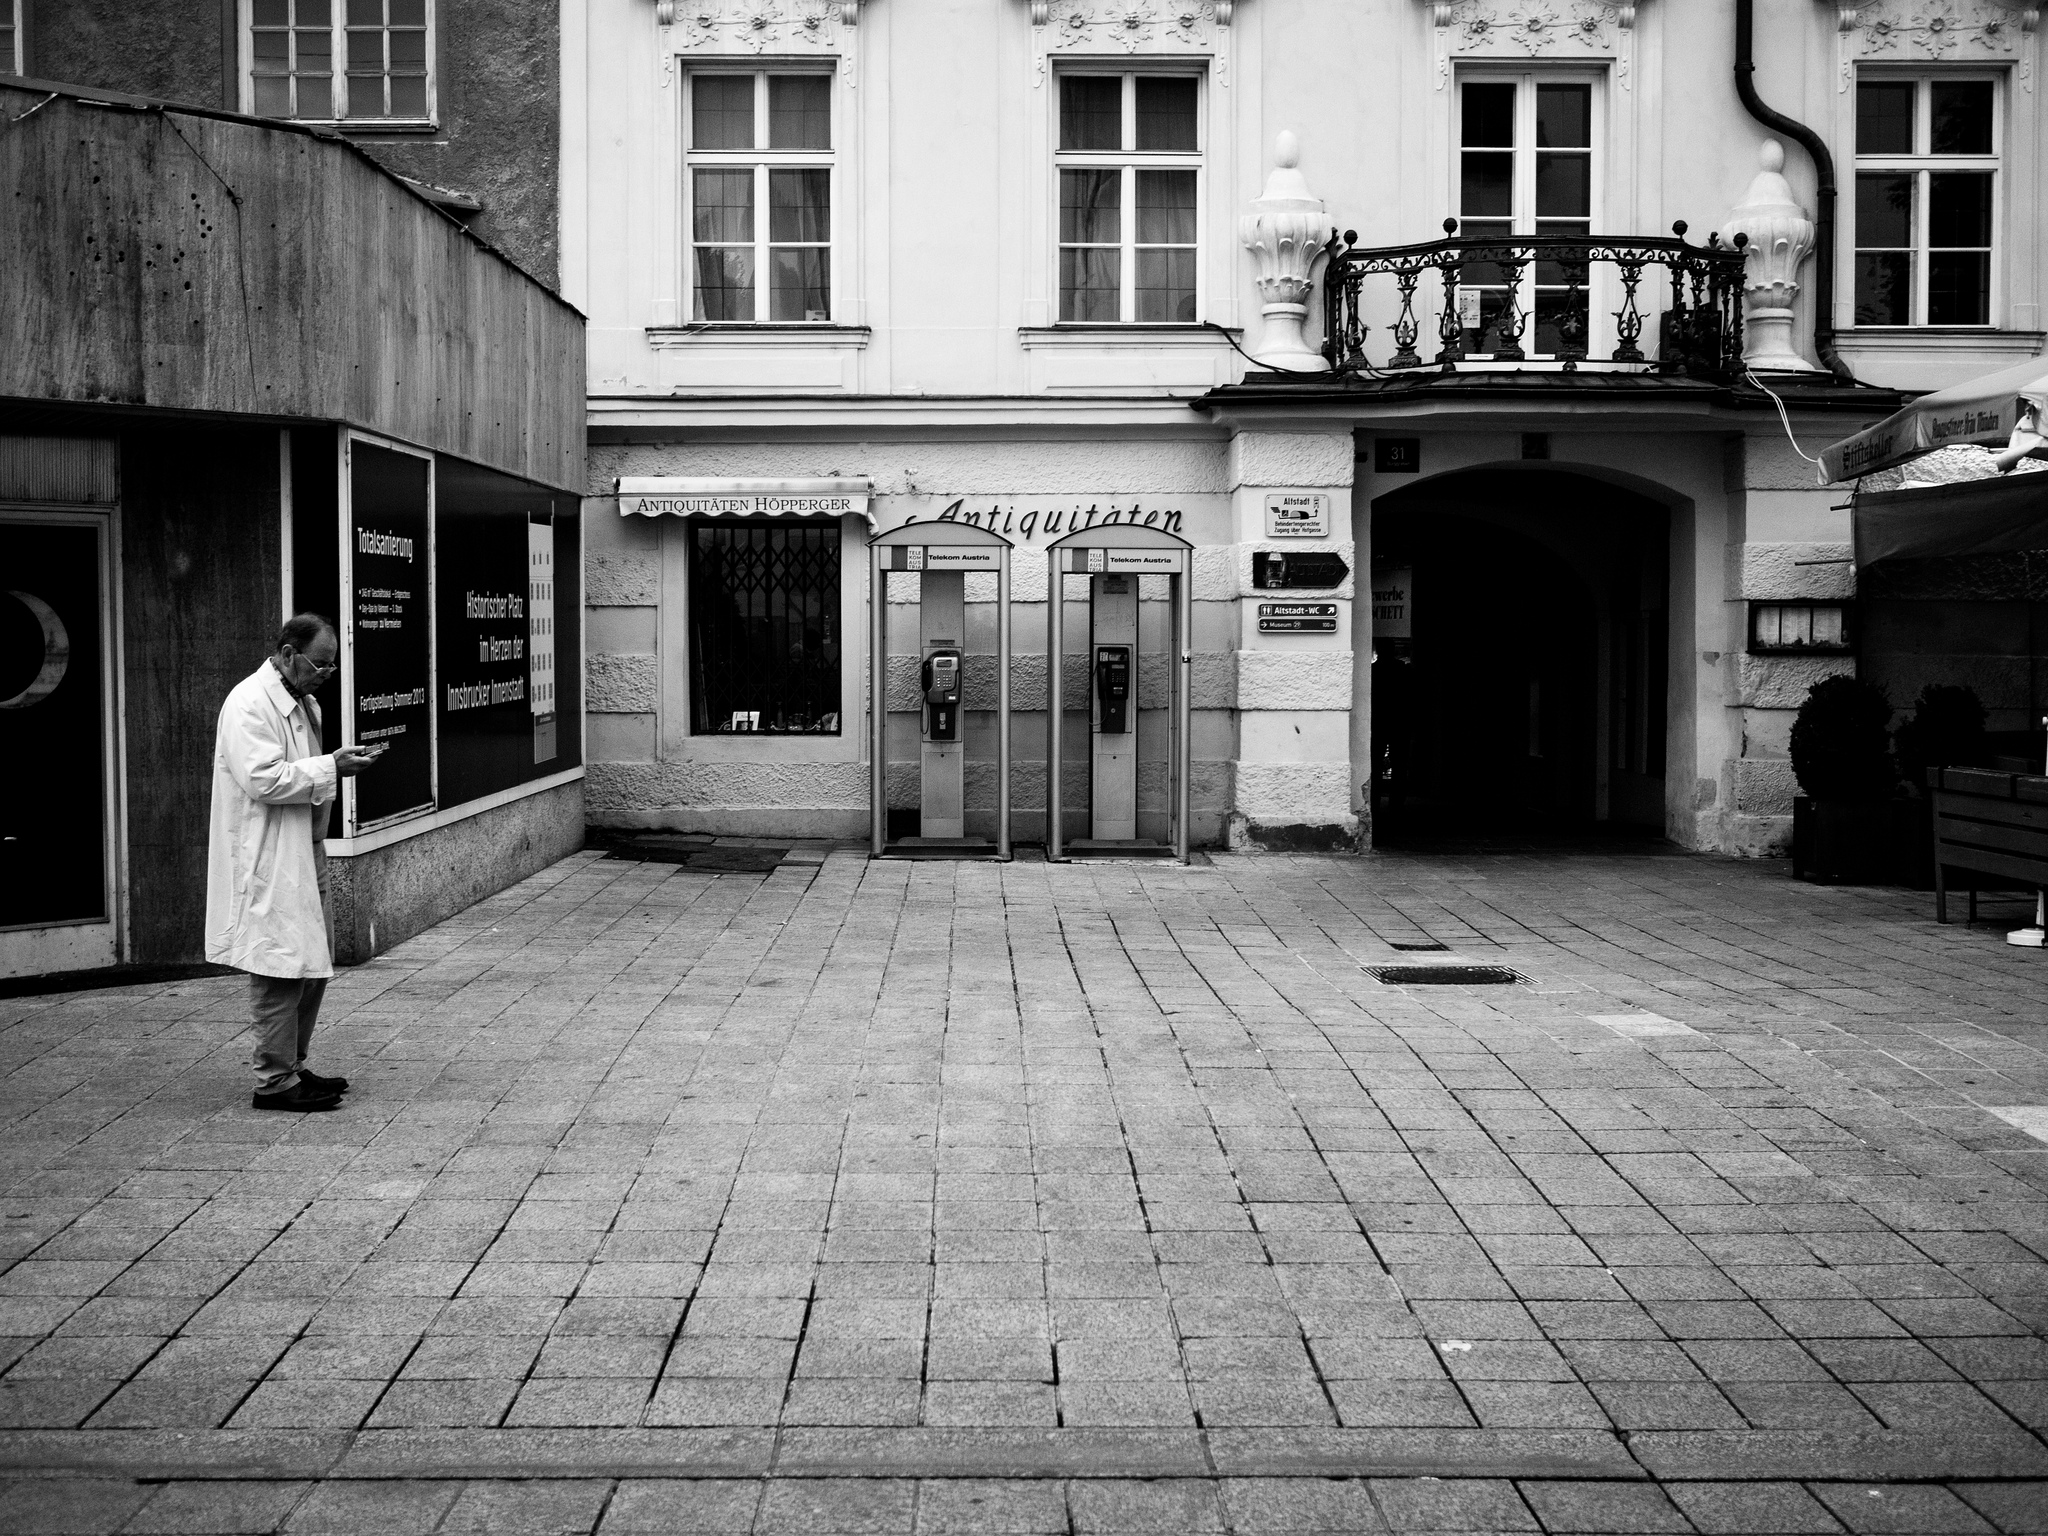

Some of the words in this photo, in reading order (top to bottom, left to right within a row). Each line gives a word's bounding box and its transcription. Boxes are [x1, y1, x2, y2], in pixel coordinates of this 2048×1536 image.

[1391, 446, 1404, 460] 31
[1842, 433, 1893, 472] Stiftskeller
[1283, 497, 1310, 505] Altstadt
[905, 498, 1182, 540] Antiquitäten
[358, 527, 413, 563] Totalsanierung
[467, 590, 507, 619] Historischer
[508, 593, 523, 618] Platz
[1274, 606, 1320, 614] Altstadt-WC
[480, 635, 488, 662] im
[490, 636, 512, 661] Herzen
[513, 635, 523, 659] der
[360, 693, 393, 713] Fertigstellung
[394, 691, 413, 707] Sommer
[413, 687, 424, 704] 2013
[448, 681, 490, 711] Innsbrucker
[492, 675, 524, 704] Innenstadt
